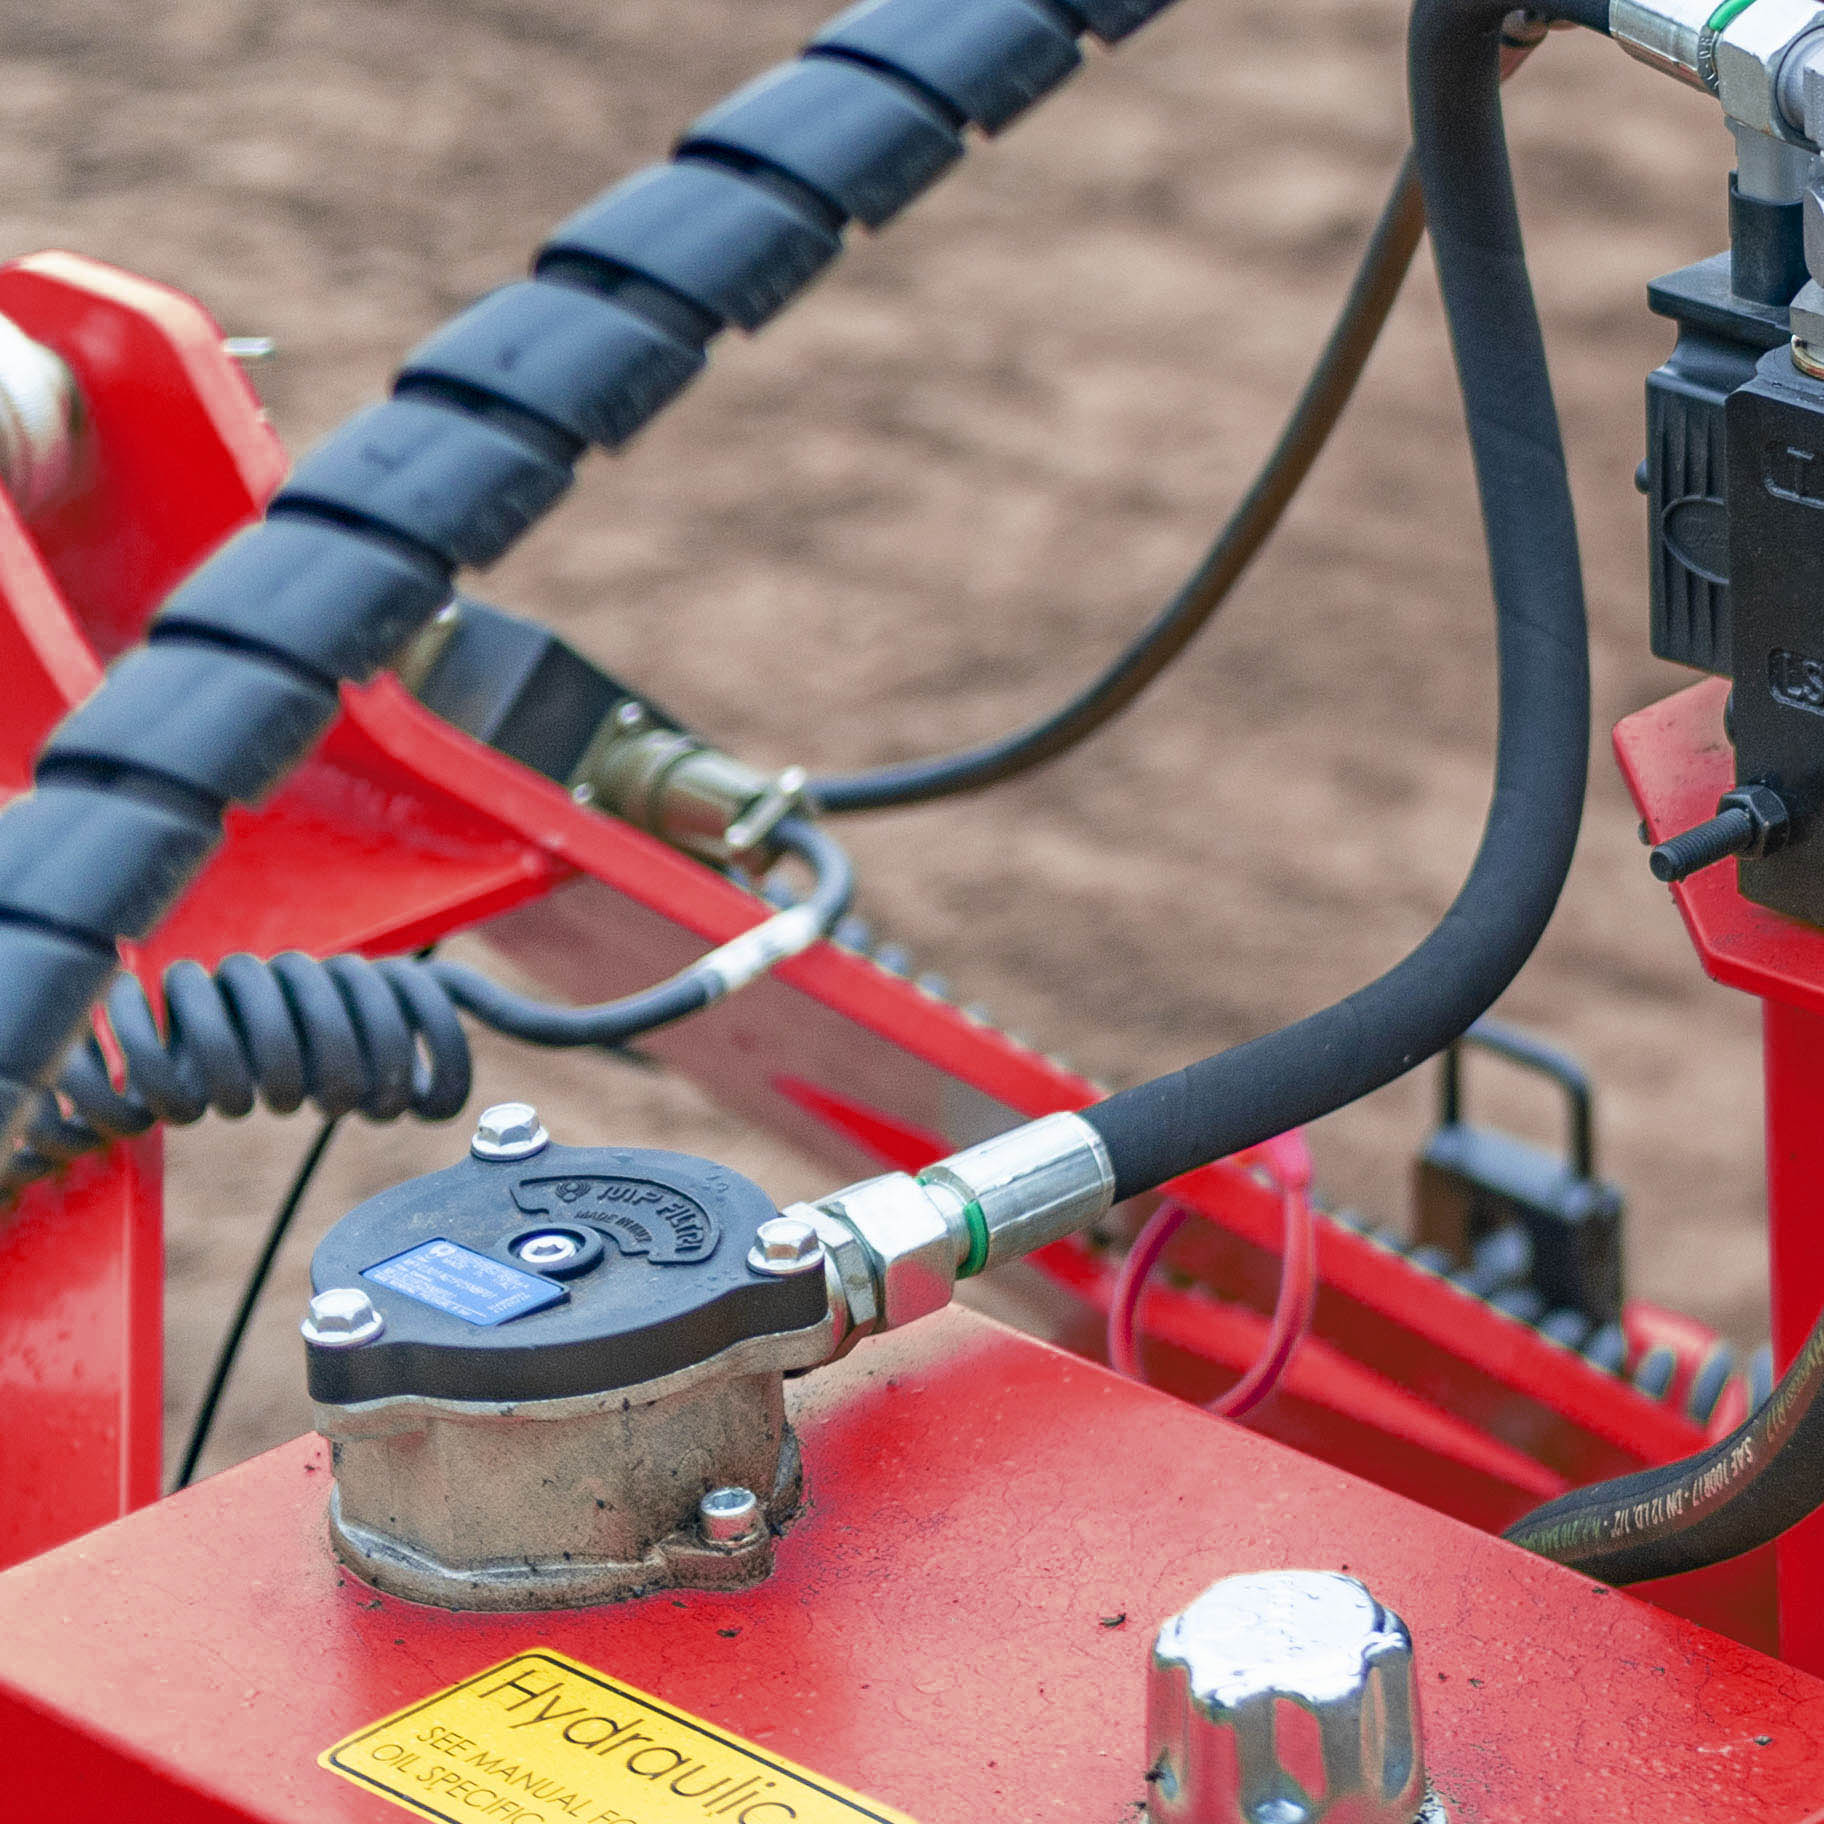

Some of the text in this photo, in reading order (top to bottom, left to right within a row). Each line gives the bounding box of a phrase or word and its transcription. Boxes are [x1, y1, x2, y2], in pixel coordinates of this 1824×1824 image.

[1731, 1436, 1753, 1477] SAE
[372, 1744, 421, 1773] OIL
[416, 1726, 477, 1757] SEE
[464, 1750, 593, 1818] MANUAL
[478, 1669, 797, 1824] Hydraulic
